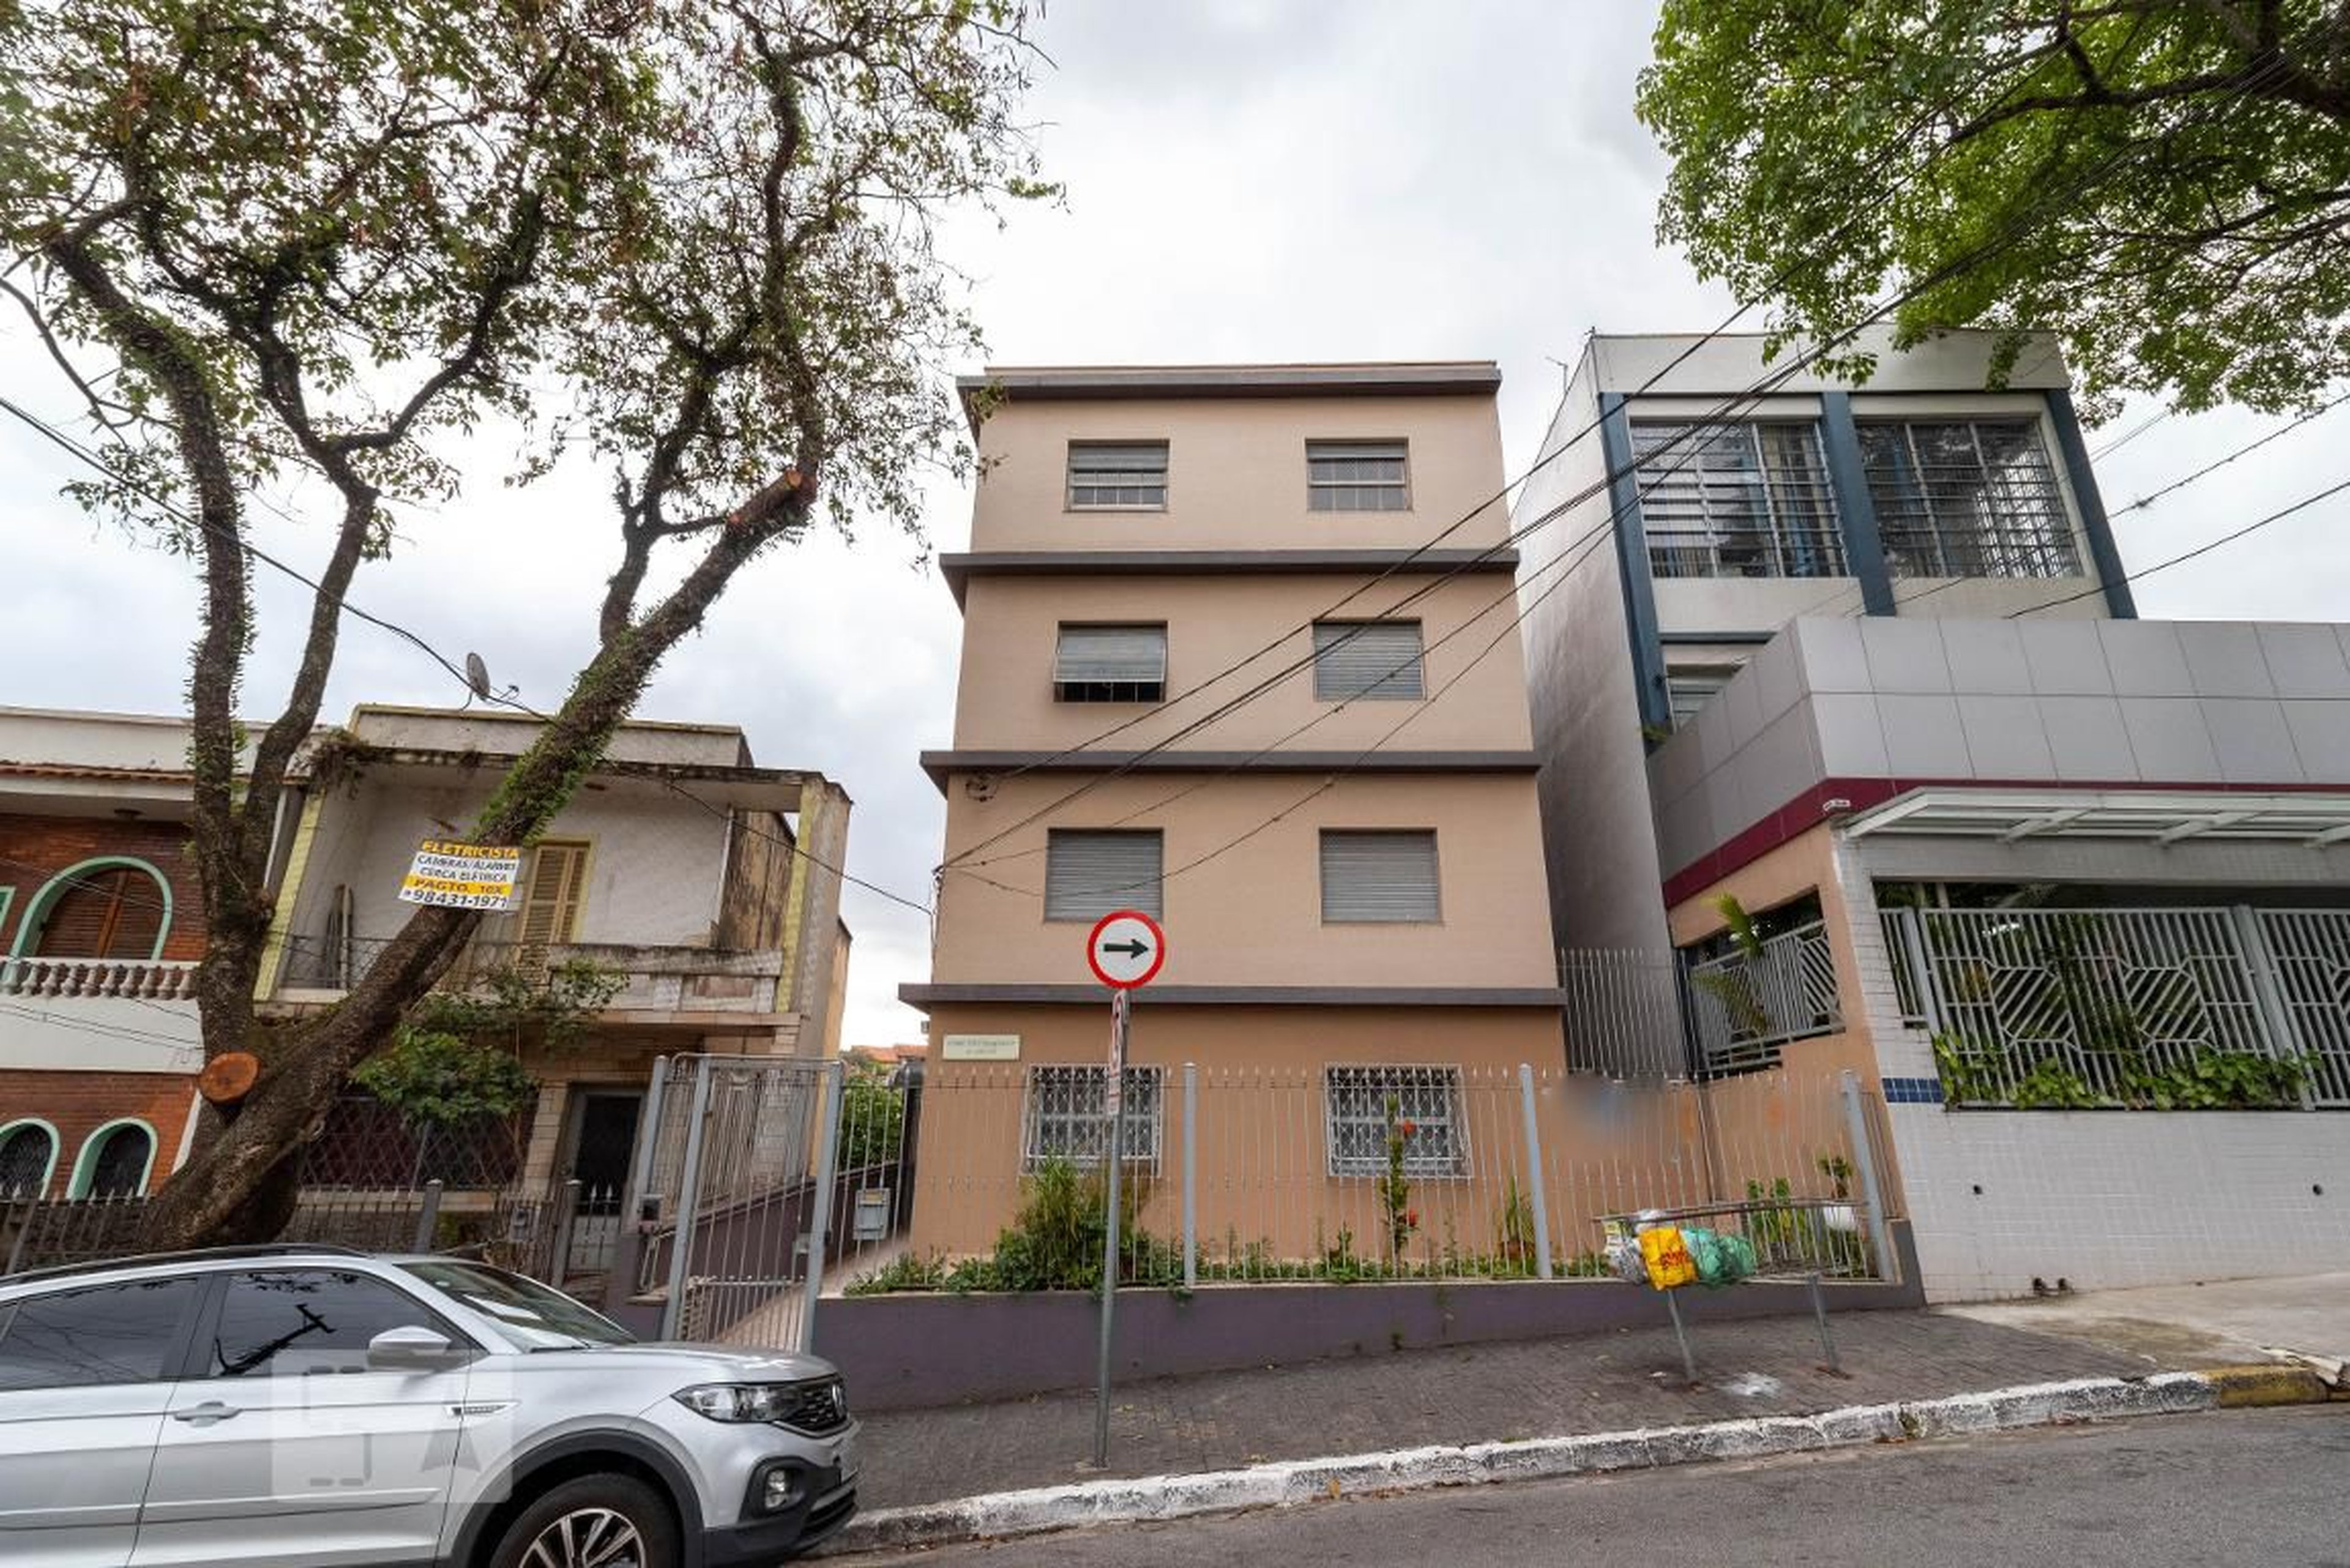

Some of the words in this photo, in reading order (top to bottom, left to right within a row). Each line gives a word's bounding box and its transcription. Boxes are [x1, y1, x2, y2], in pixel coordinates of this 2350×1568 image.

[422, 841, 519, 858] ELETRICISTA
[420, 867, 456, 879] CERCA
[480, 884, 502, 894] 10X
[413, 889, 508, 908] 98431-1971
